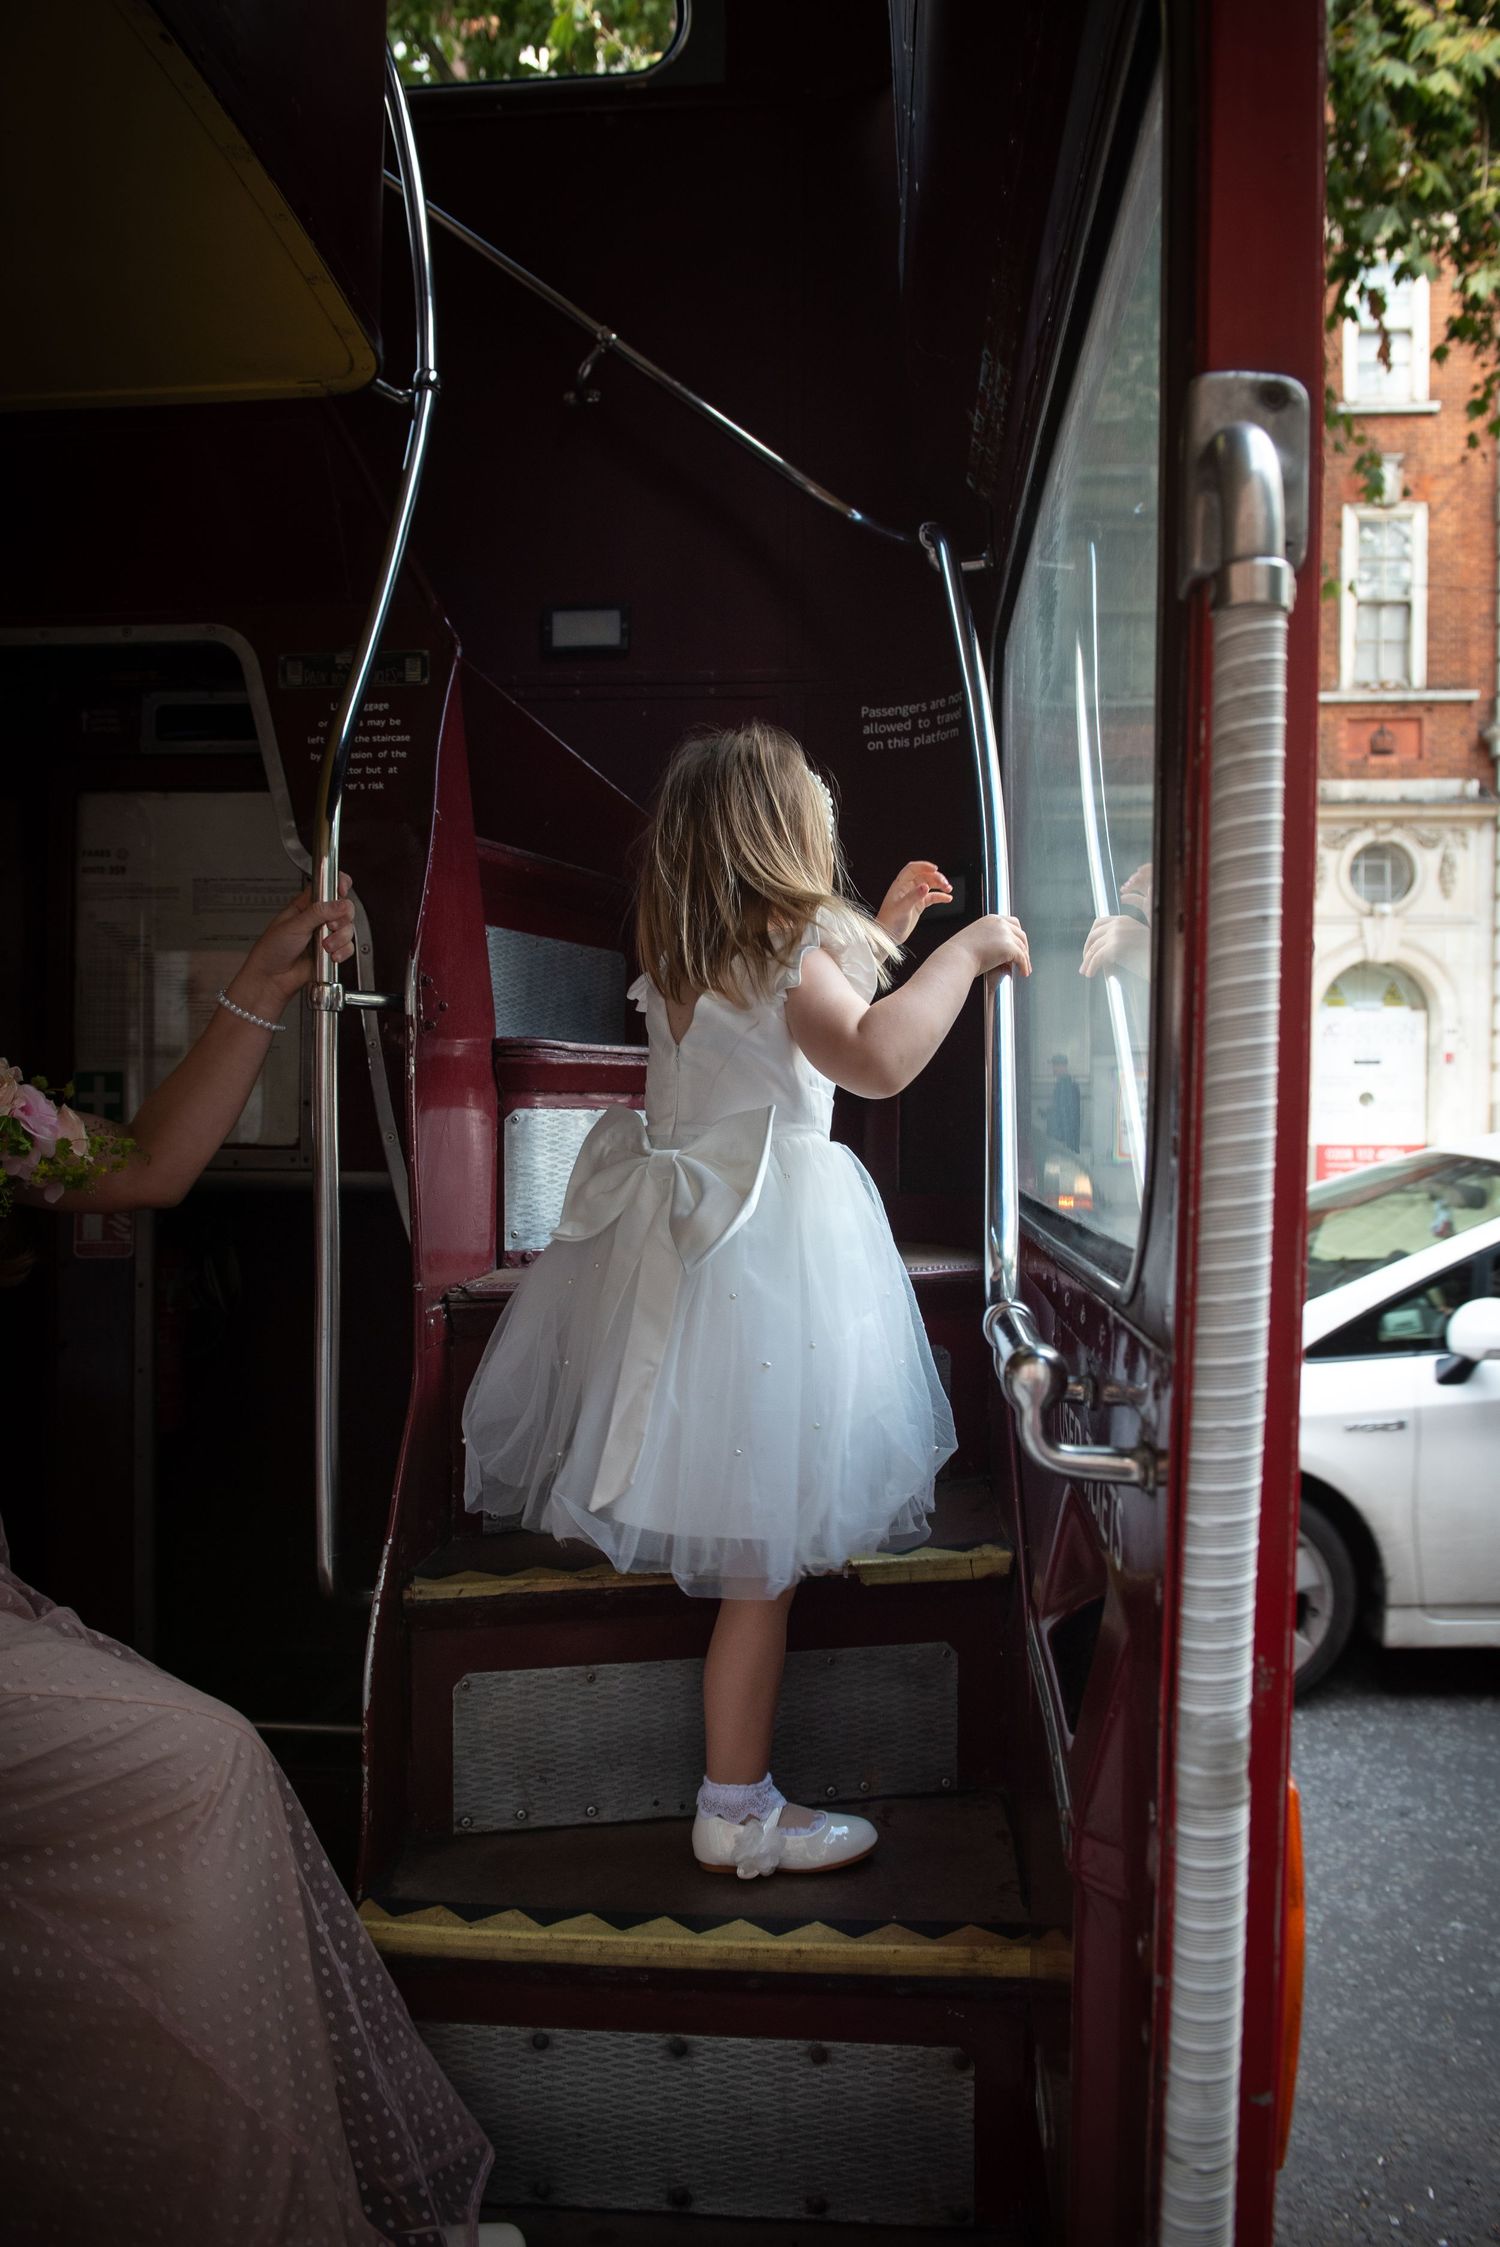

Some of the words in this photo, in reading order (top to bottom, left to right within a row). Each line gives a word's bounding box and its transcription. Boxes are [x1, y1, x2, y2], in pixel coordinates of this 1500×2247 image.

[861, 702, 927, 718] Passengers
[930, 698, 946, 711] are
[948, 691, 963, 705] not
[366, 719, 386, 728] may
[389, 717, 401, 727] be
[862, 719, 912, 735] allowed
[918, 718, 931, 729] to
[936, 708, 962, 725] travel
[307, 735, 325, 745] left
[354, 734, 370, 743] the
[372, 733, 411, 742] staircase
[867, 740, 884, 751] on
[887, 736, 910, 749] this
[913, 727, 959, 749] platform
[310, 751, 322, 762] by
[377, 749, 387, 758] of
[391, 749, 407, 758] the
[365, 766, 381, 775] but
[387, 766, 398, 775] at
[368, 781, 384, 790] risk
